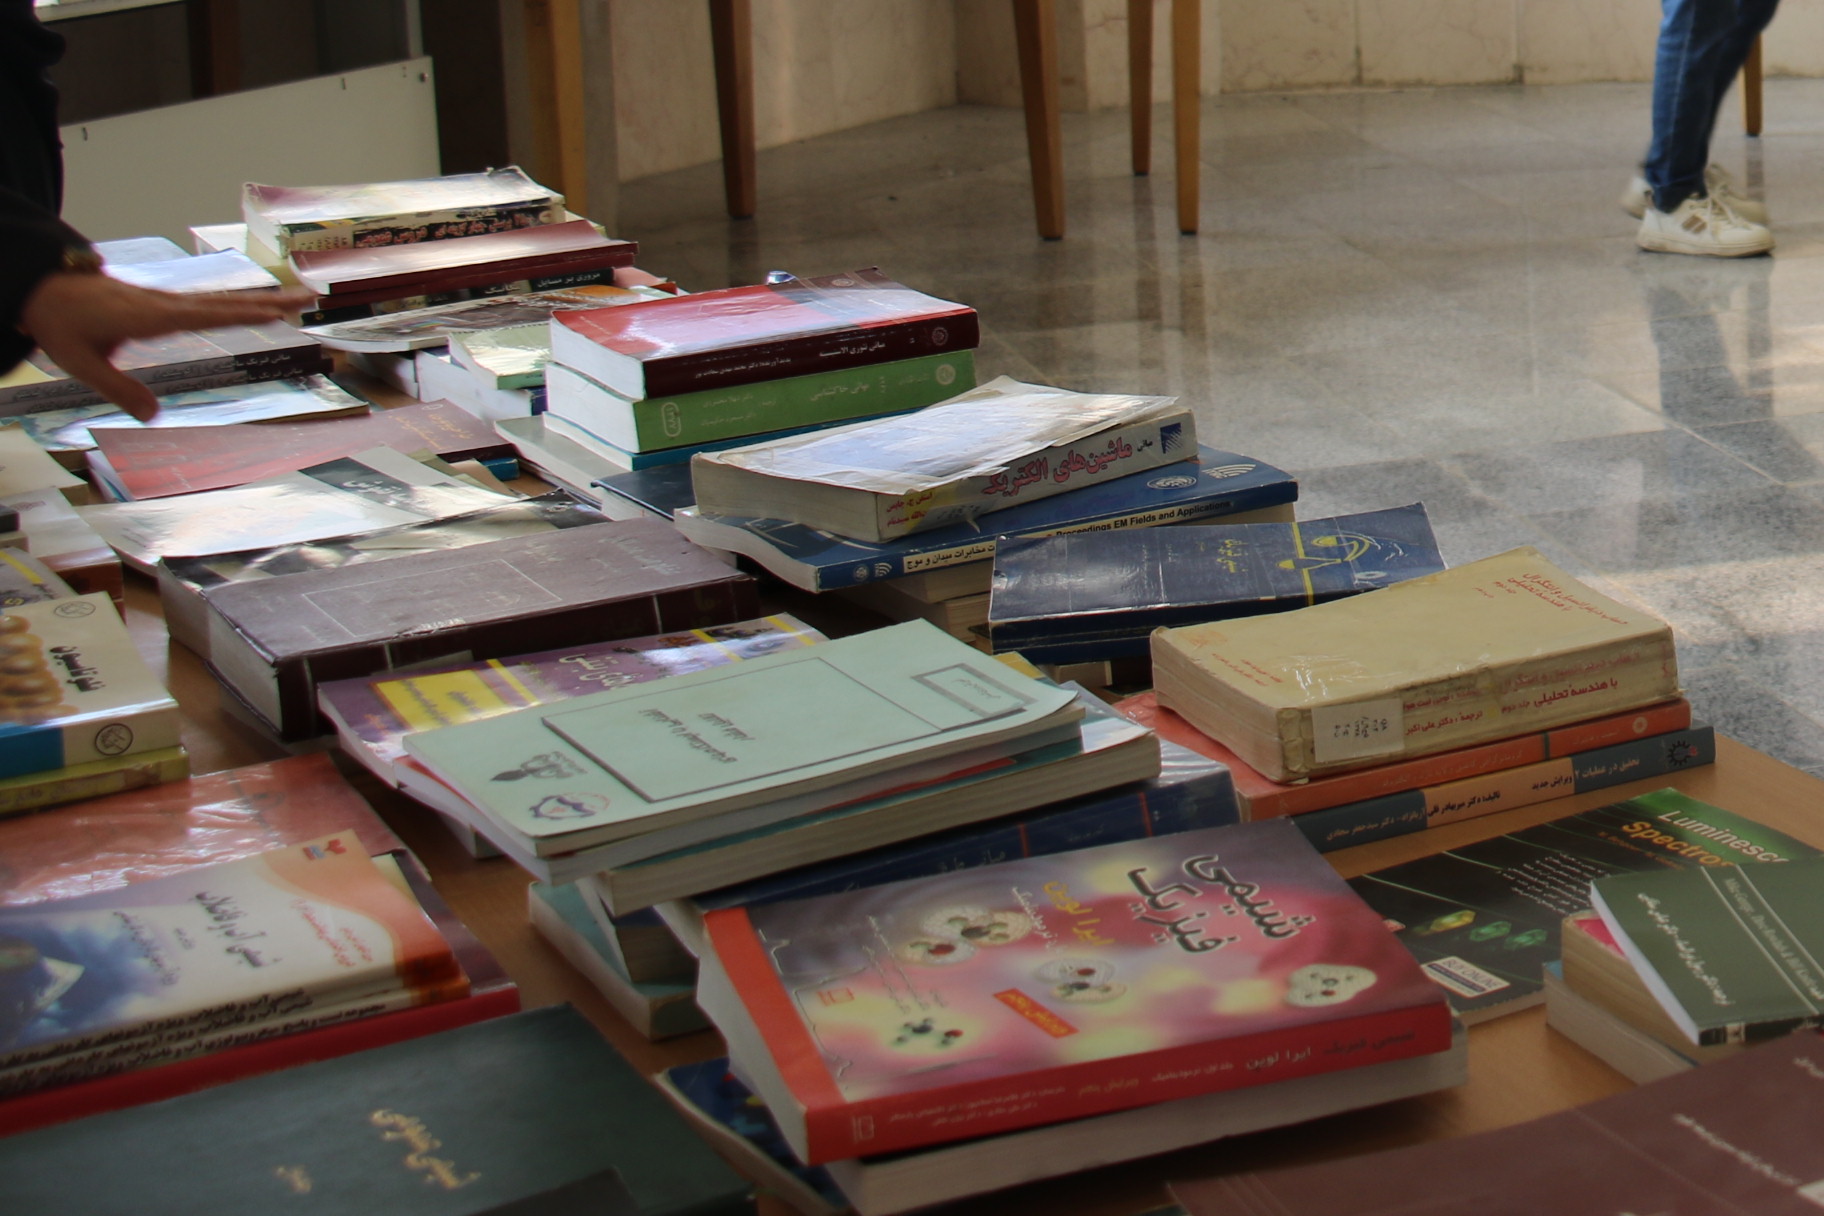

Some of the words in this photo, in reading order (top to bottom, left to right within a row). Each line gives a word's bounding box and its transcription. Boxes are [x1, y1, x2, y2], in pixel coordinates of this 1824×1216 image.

[1114, 518, 1129, 530] EM
[1130, 514, 1157, 527] Fields
[1158, 509, 1176, 521] and
[1177, 499, 1232, 519] Applications
[1127, 866, 1240, 954] فیزیک
[1182, 854, 1316, 939] شیمی
